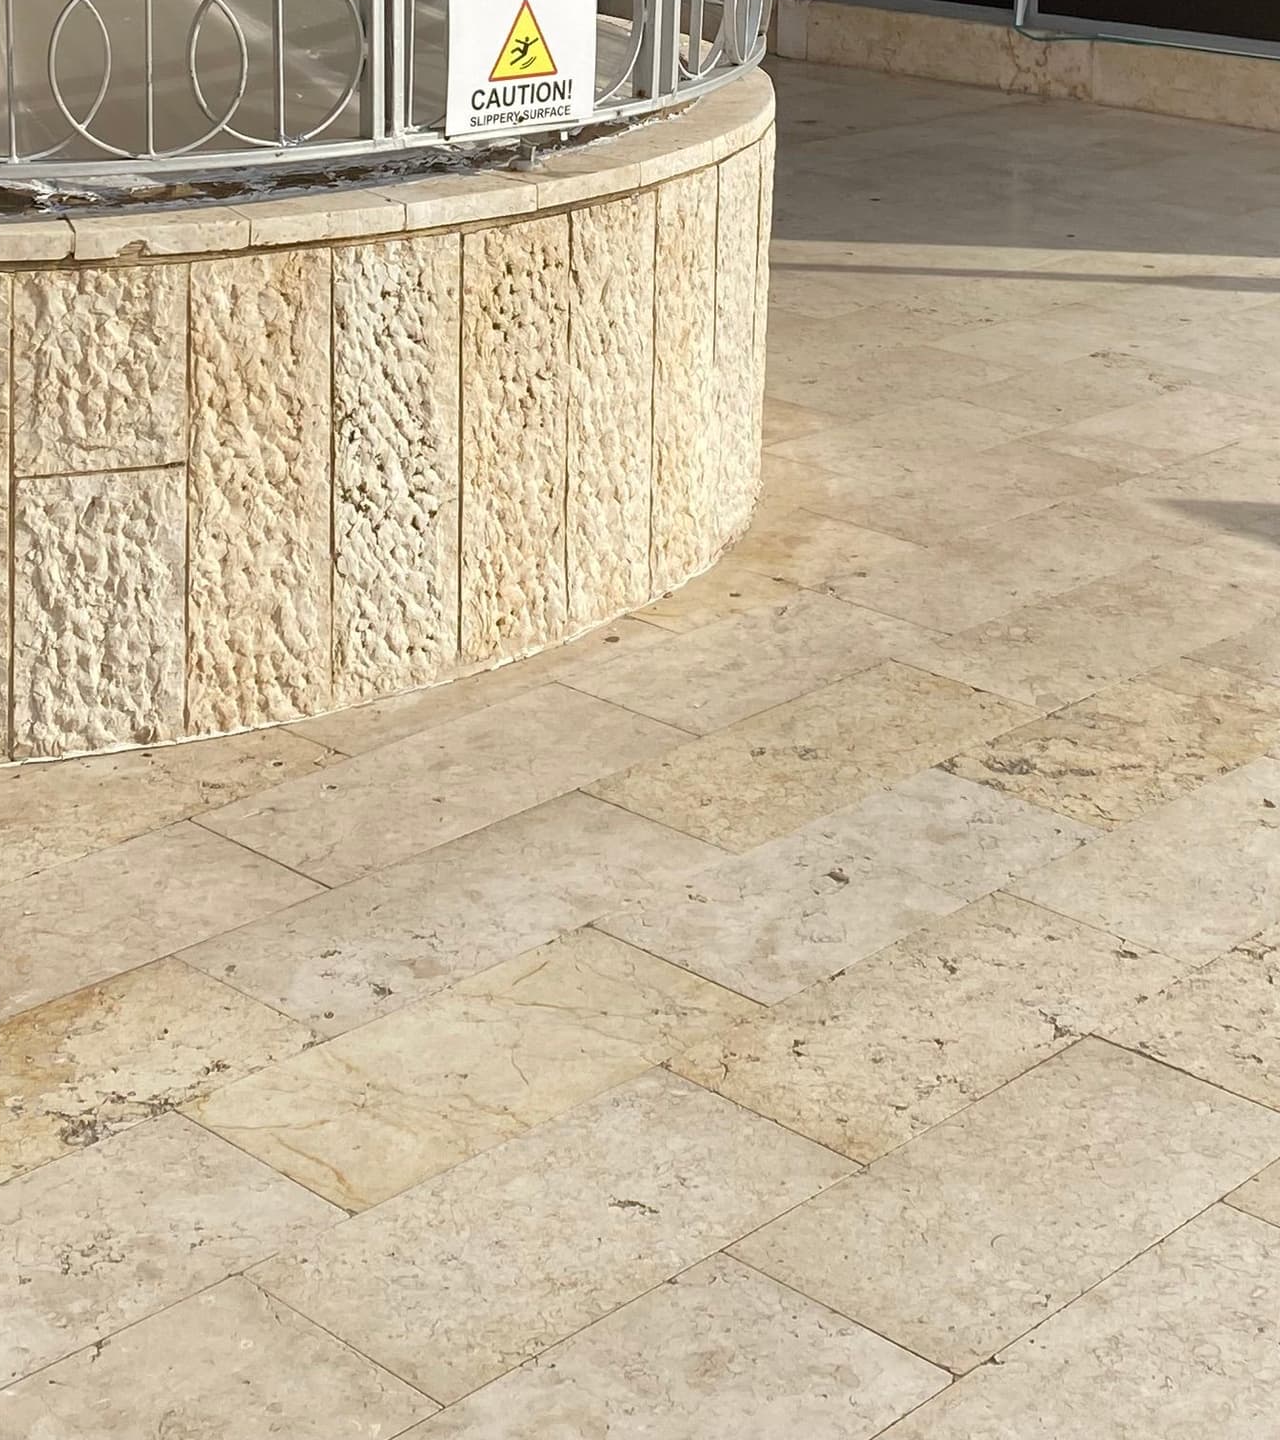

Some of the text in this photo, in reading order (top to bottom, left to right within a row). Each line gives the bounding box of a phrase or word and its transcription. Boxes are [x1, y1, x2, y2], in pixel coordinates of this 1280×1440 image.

[470, 79, 573, 110] CAUTION!
[470, 106, 571, 128] SLIPPERY SURFACE
